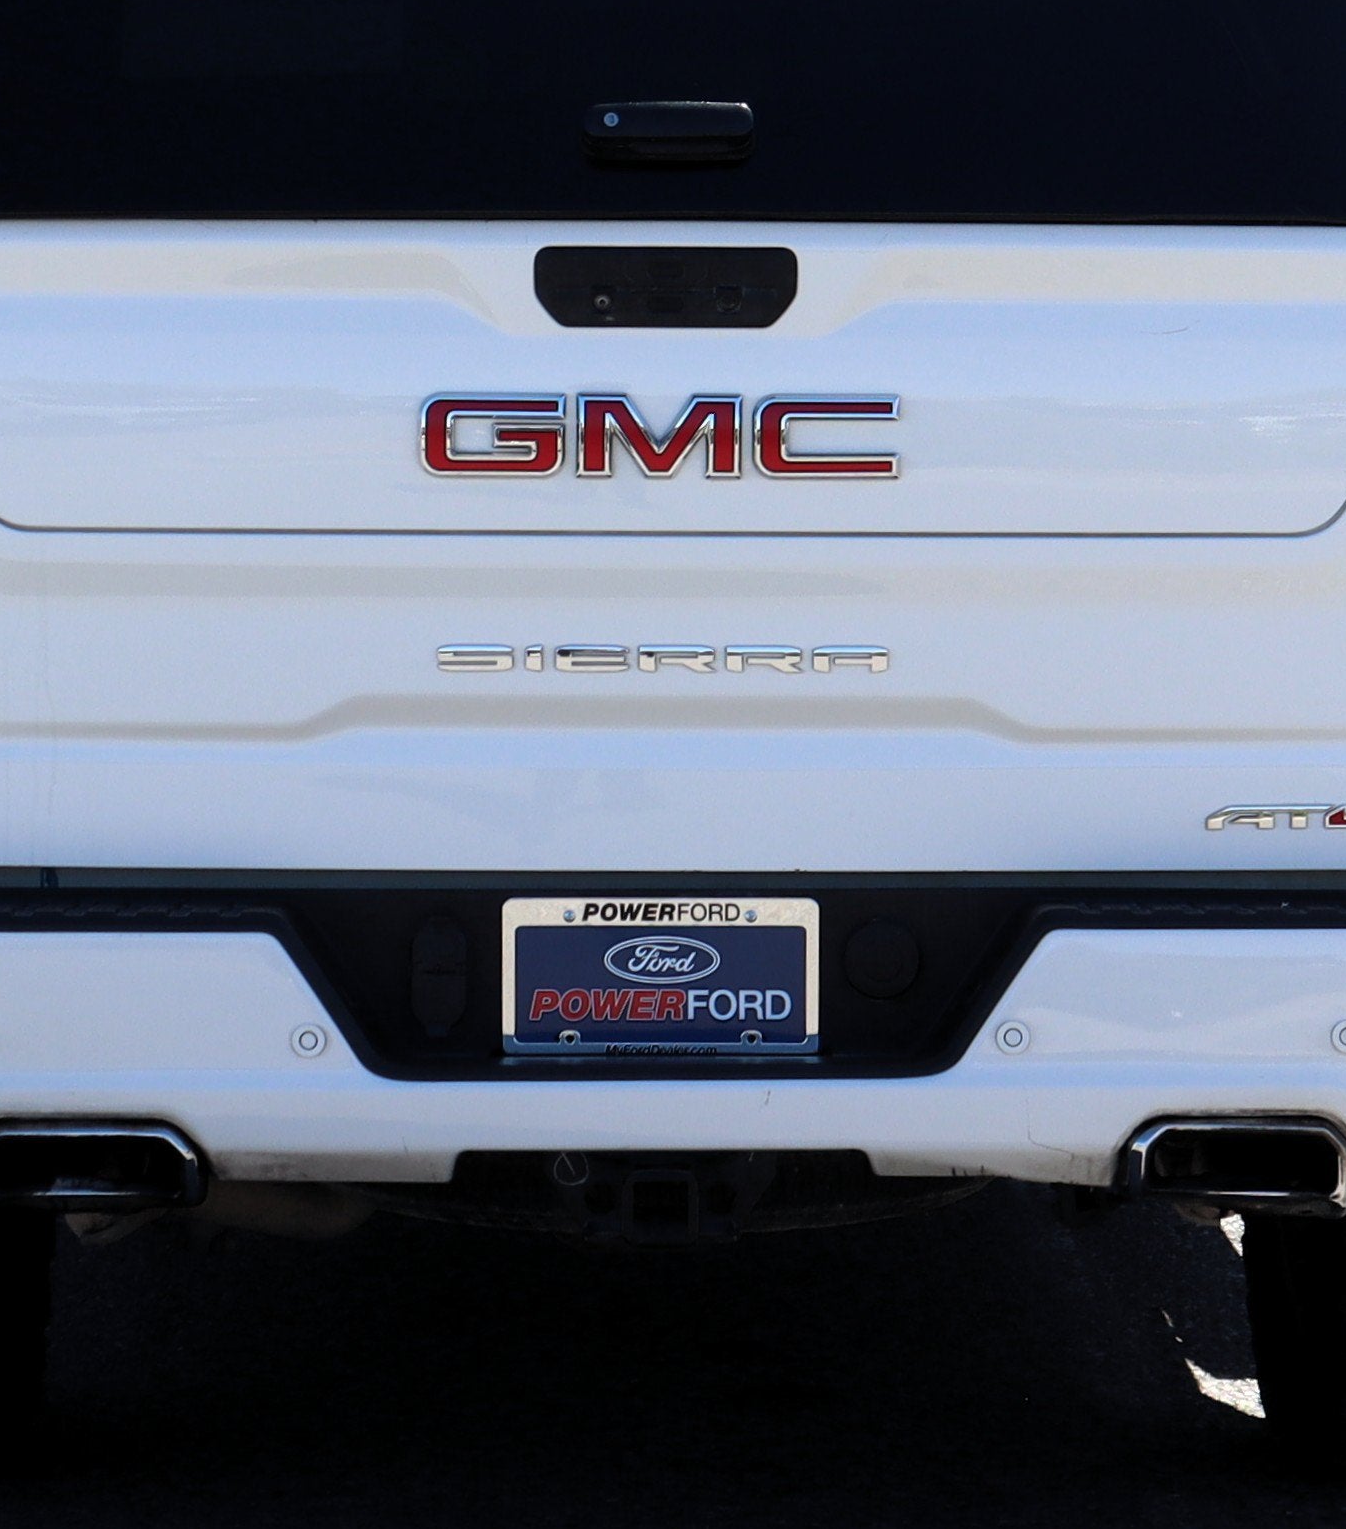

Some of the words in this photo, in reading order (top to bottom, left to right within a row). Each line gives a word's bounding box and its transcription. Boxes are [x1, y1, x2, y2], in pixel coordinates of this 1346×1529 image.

[420, 393, 901, 479] GMC
[436, 643, 890, 673] SIERRA
[581, 902, 741, 922] POWERFORD
[627, 945, 697, 973] Ford
[529, 988, 792, 1022] POWERFORD
